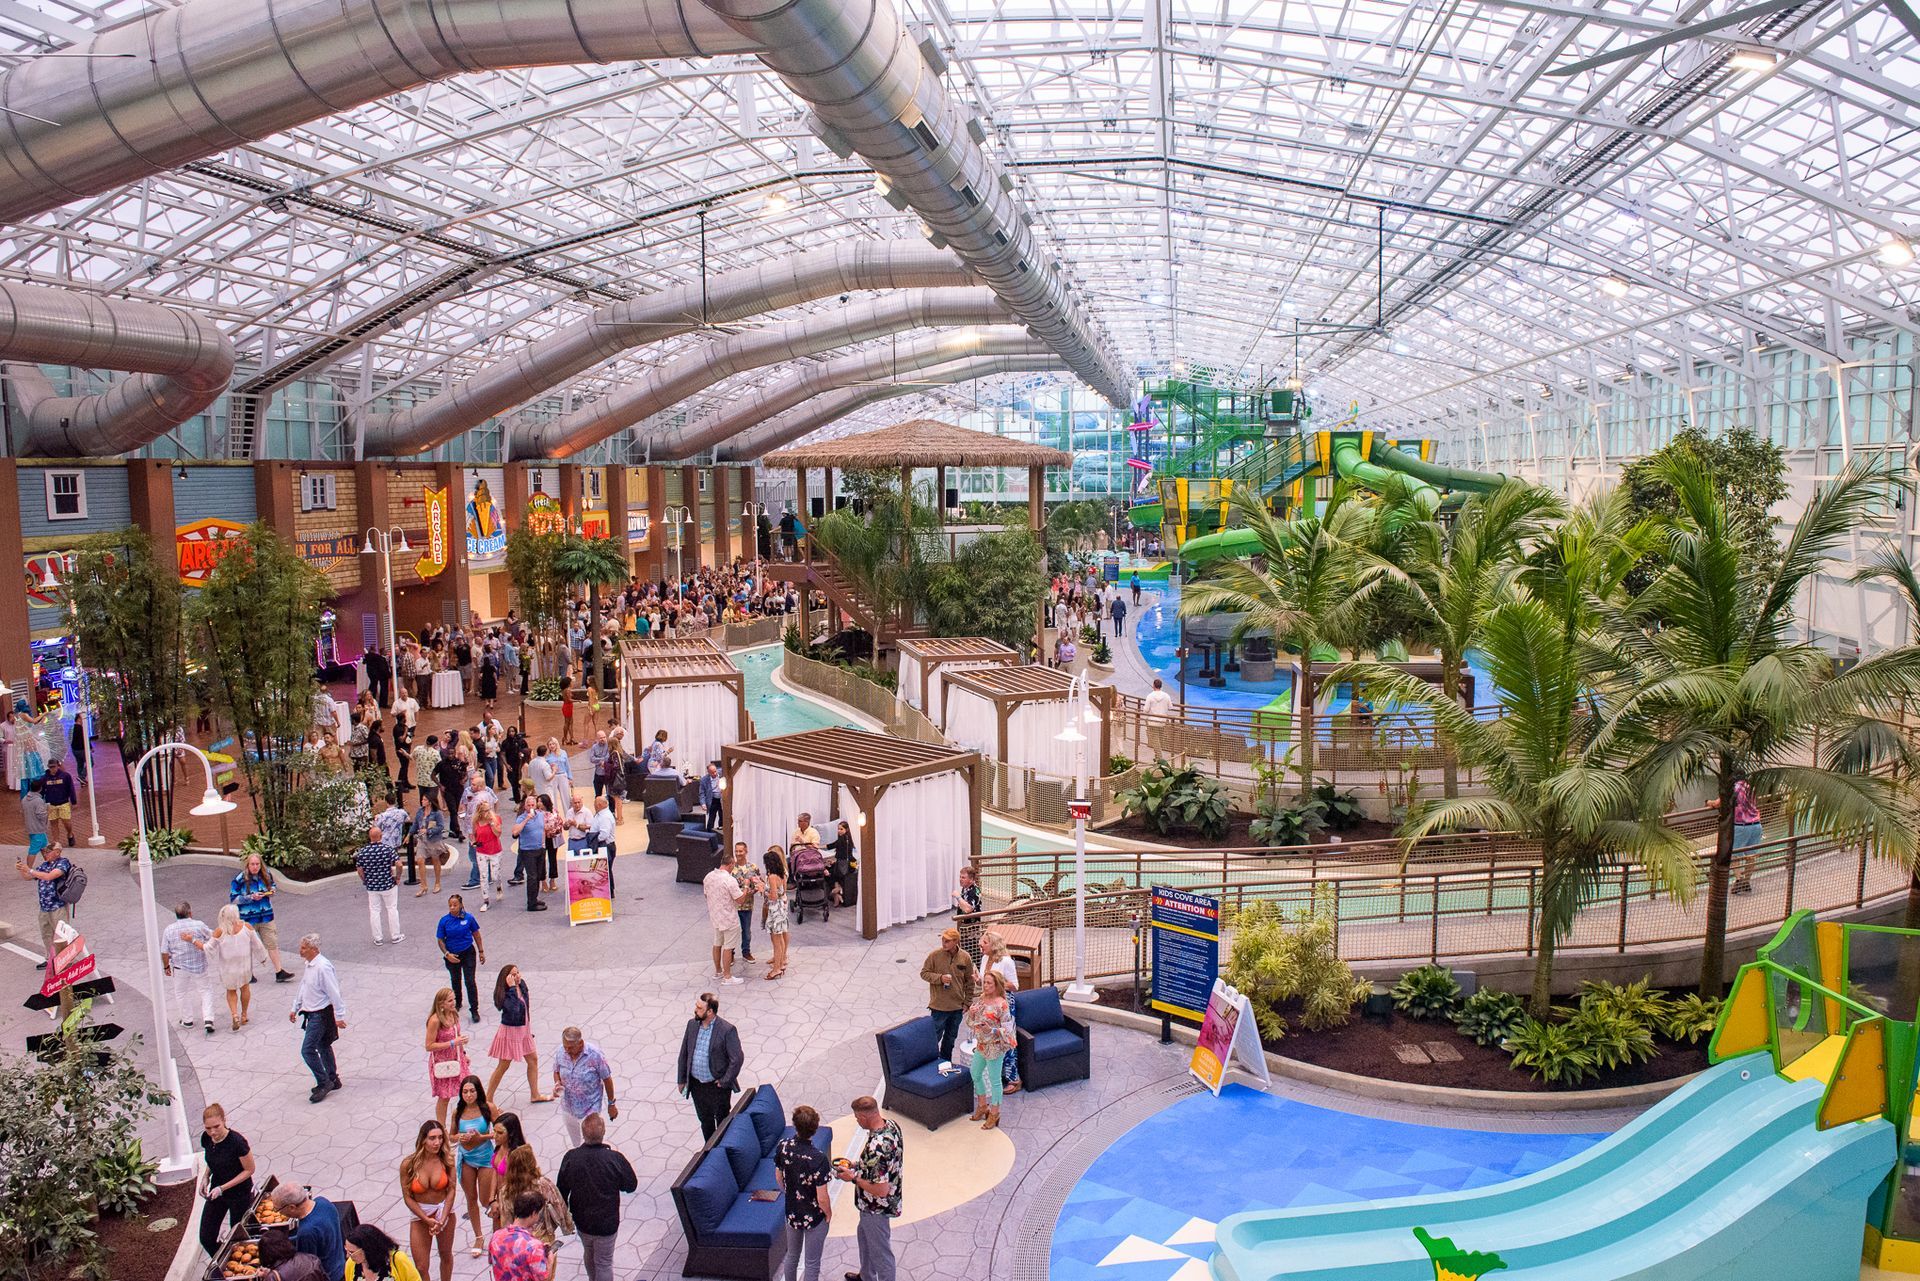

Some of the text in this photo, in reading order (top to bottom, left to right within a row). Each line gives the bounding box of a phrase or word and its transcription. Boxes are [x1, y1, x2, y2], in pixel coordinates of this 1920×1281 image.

[432, 501, 442, 563] ARCADE
[582, 519, 610, 540] RILL
[310, 542, 332, 555] FOR
[336, 537, 356, 555] ALL
[466, 534, 506, 553] CE CREAM
[1158, 889, 1212, 907] KIDS COVE AREA
[1164, 899, 1205, 915] ATTENTION
